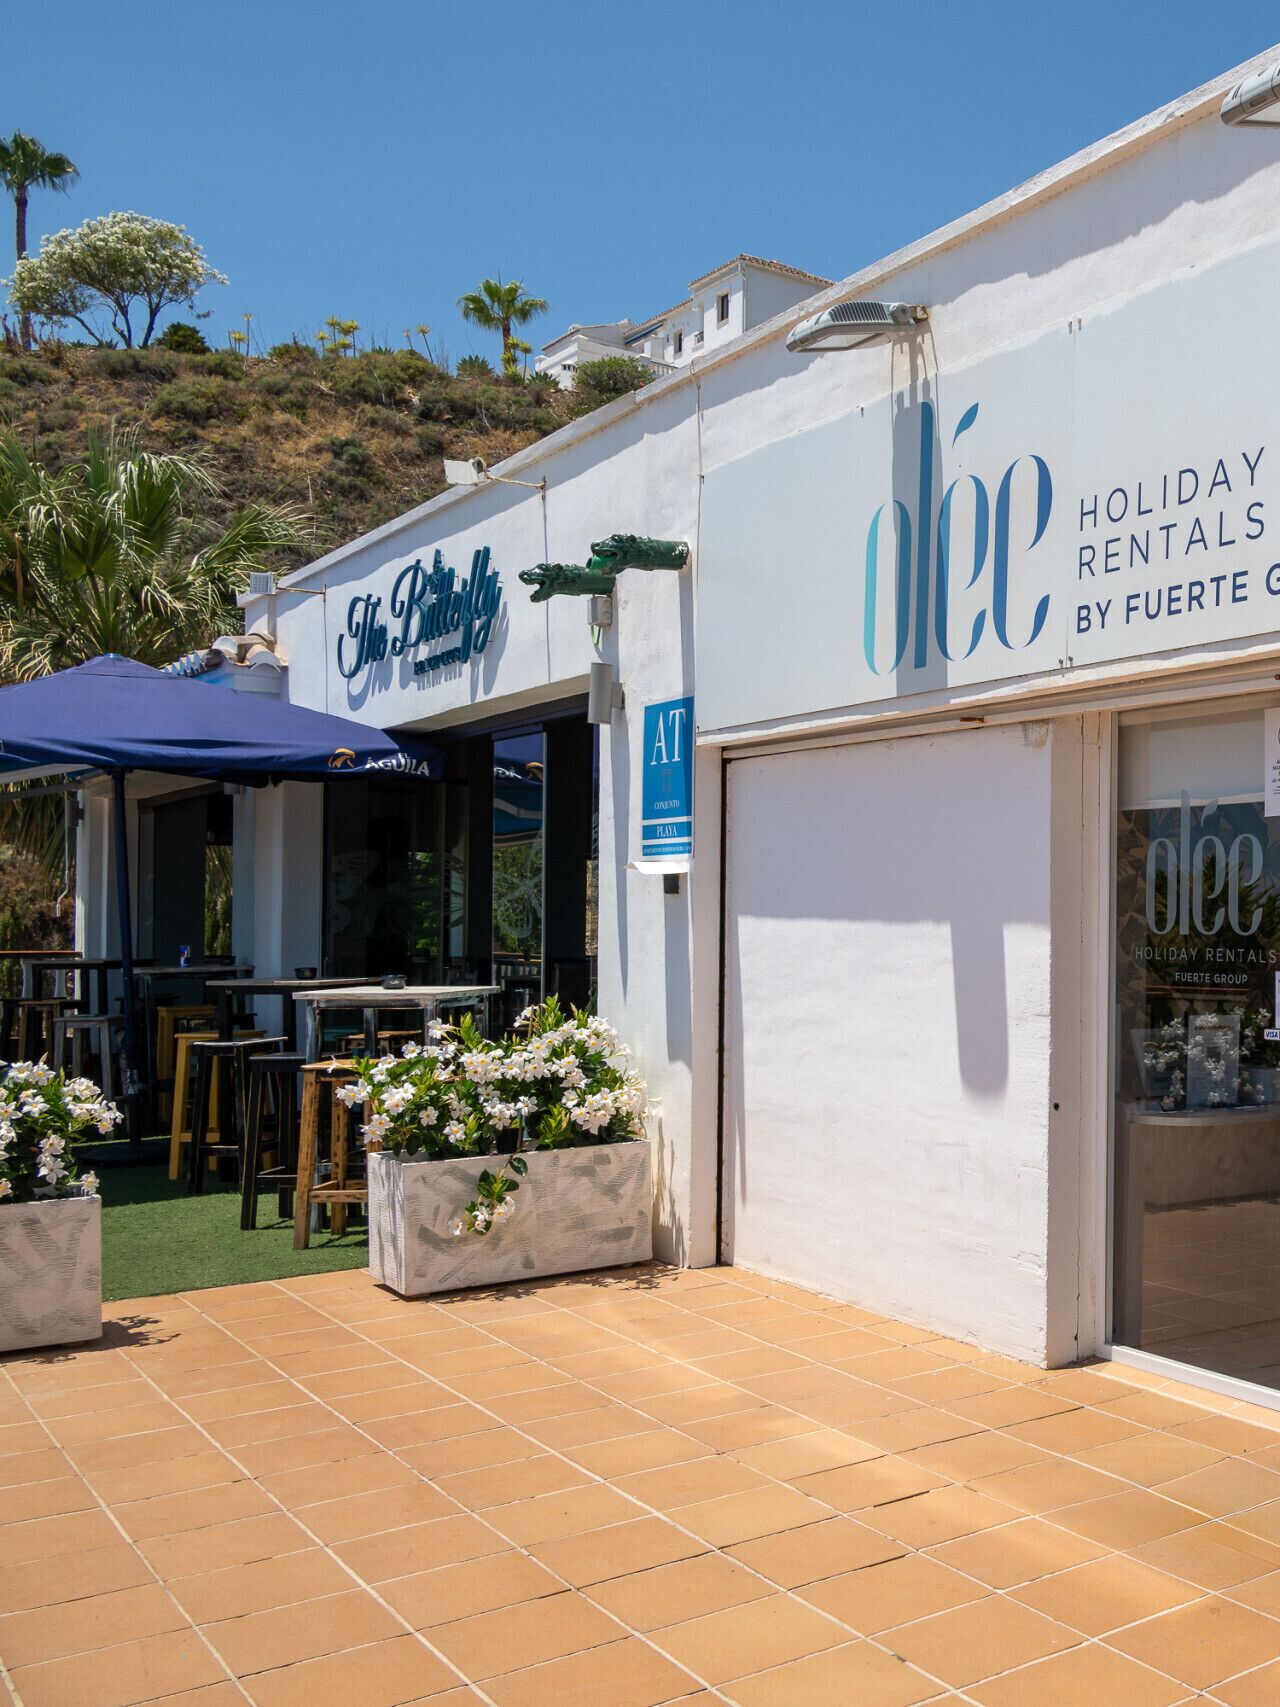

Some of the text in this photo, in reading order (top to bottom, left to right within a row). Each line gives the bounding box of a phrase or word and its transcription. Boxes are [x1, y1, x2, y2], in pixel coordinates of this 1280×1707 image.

[1080, 446, 1264, 532] HOLIDAY
[863, 401, 1053, 676] olée
[1078, 501, 1264, 580] RENTALS
[337, 545, 503, 679] The Butterfly
[1076, 599, 1112, 634] BY
[1125, 570, 1249, 625] FUERTE
[364, 756, 430, 777] ÁGUILA
[650, 708, 687, 765] AT
[653, 799, 681, 810] CONJUNTO
[656, 825, 678, 837] PLAYA
[1145, 789, 1264, 937] olée
[1135, 946, 1277, 964] HOLIDAY RENTALS
[1175, 972, 1248, 985] FUERTE GROUP
